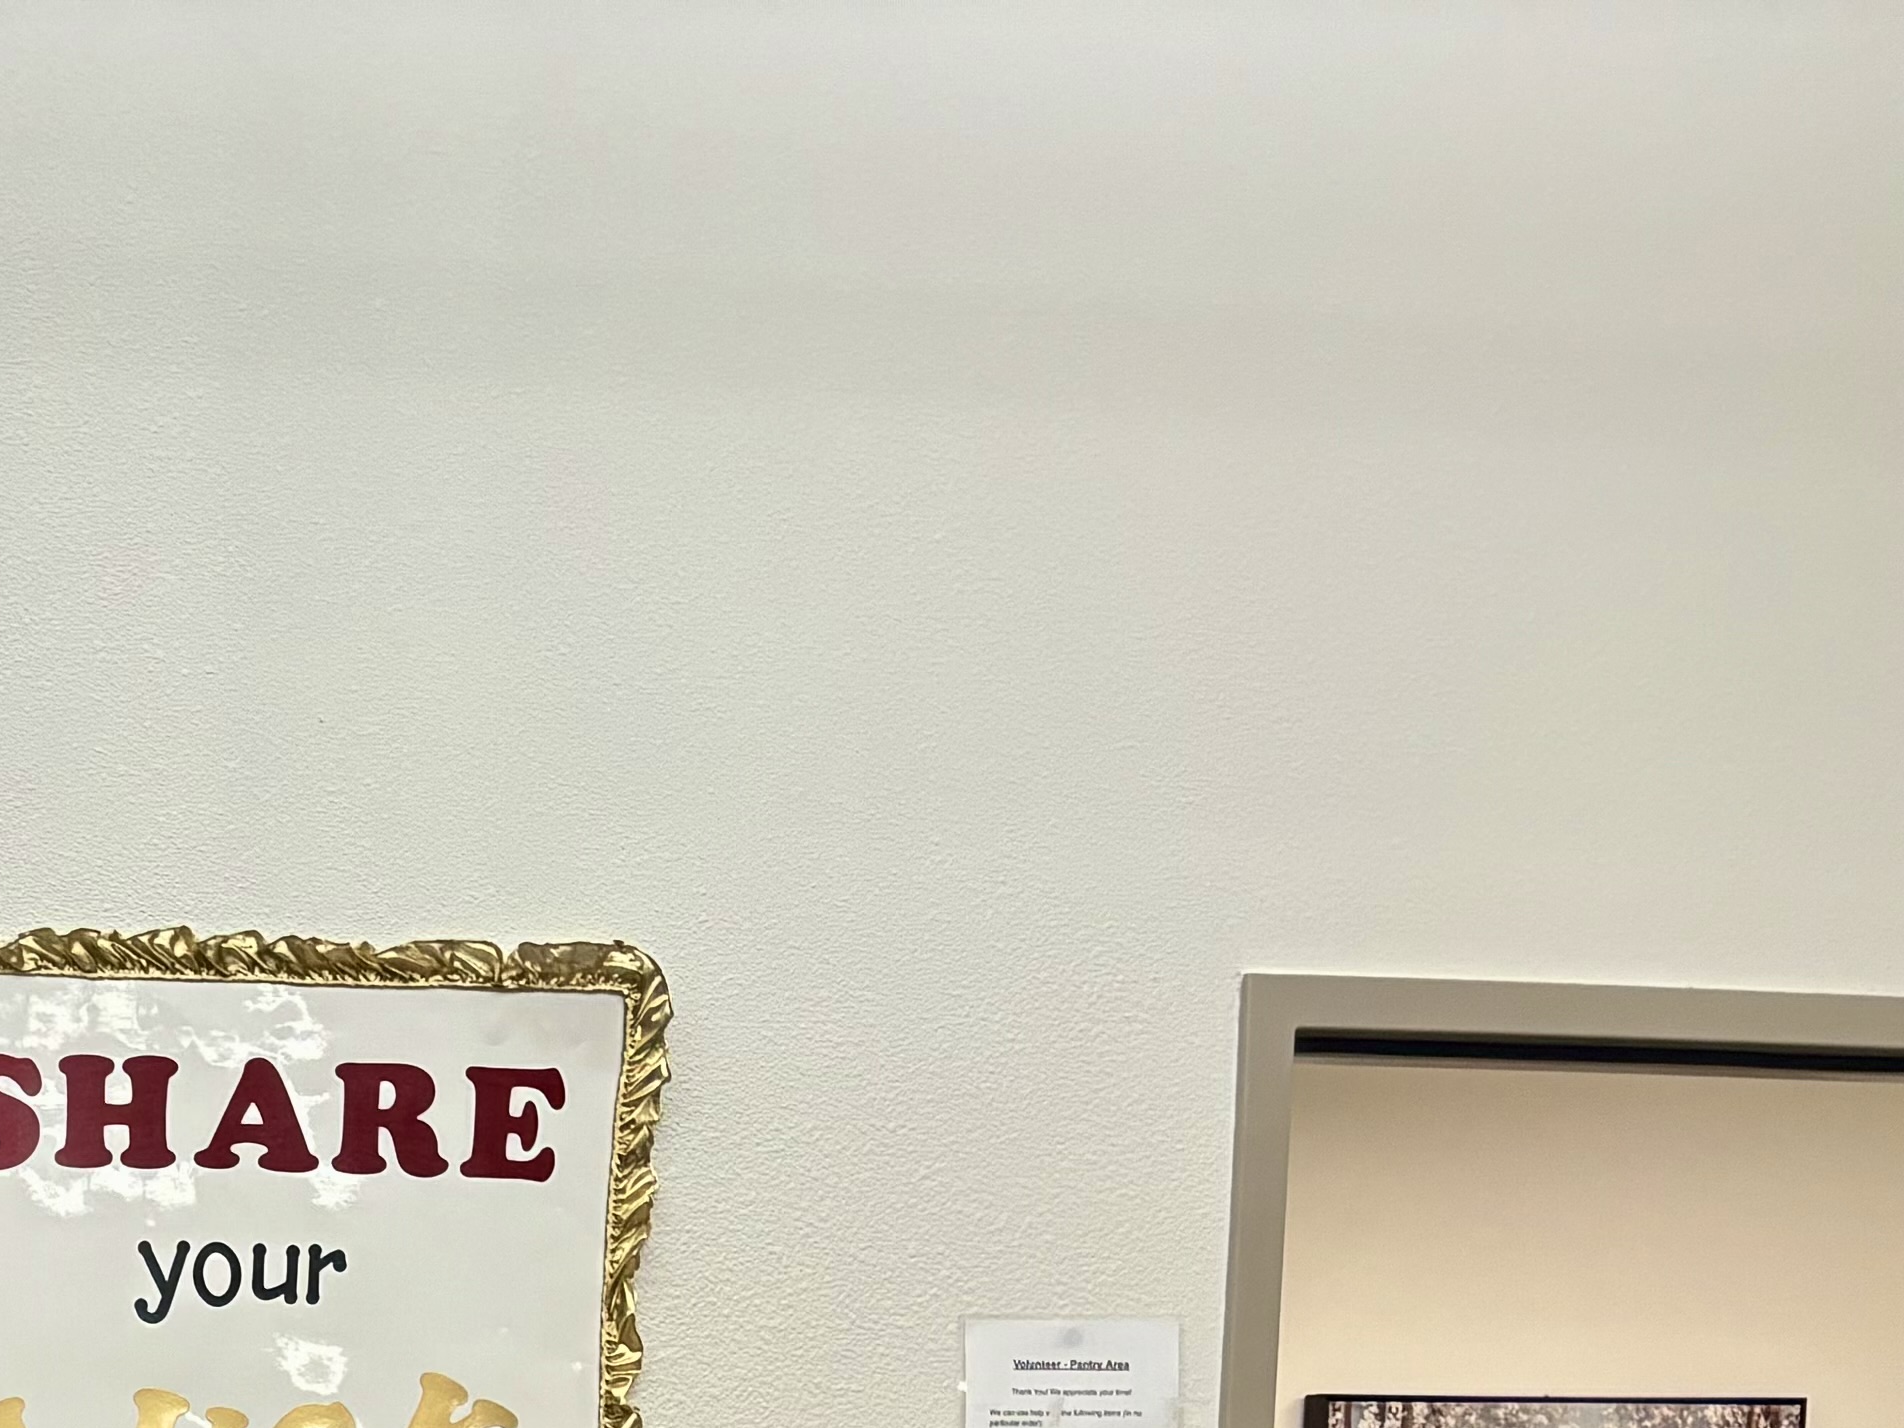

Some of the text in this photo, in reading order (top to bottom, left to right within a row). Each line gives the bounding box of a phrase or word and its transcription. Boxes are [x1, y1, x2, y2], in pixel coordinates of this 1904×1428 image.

[134, 1239, 348, 1325] your
[1013, 1359, 1061, 1370] Volunteer
[1070, 1359, 1102, 1371] Pantry
[1106, 1359, 1130, 1370] Area
